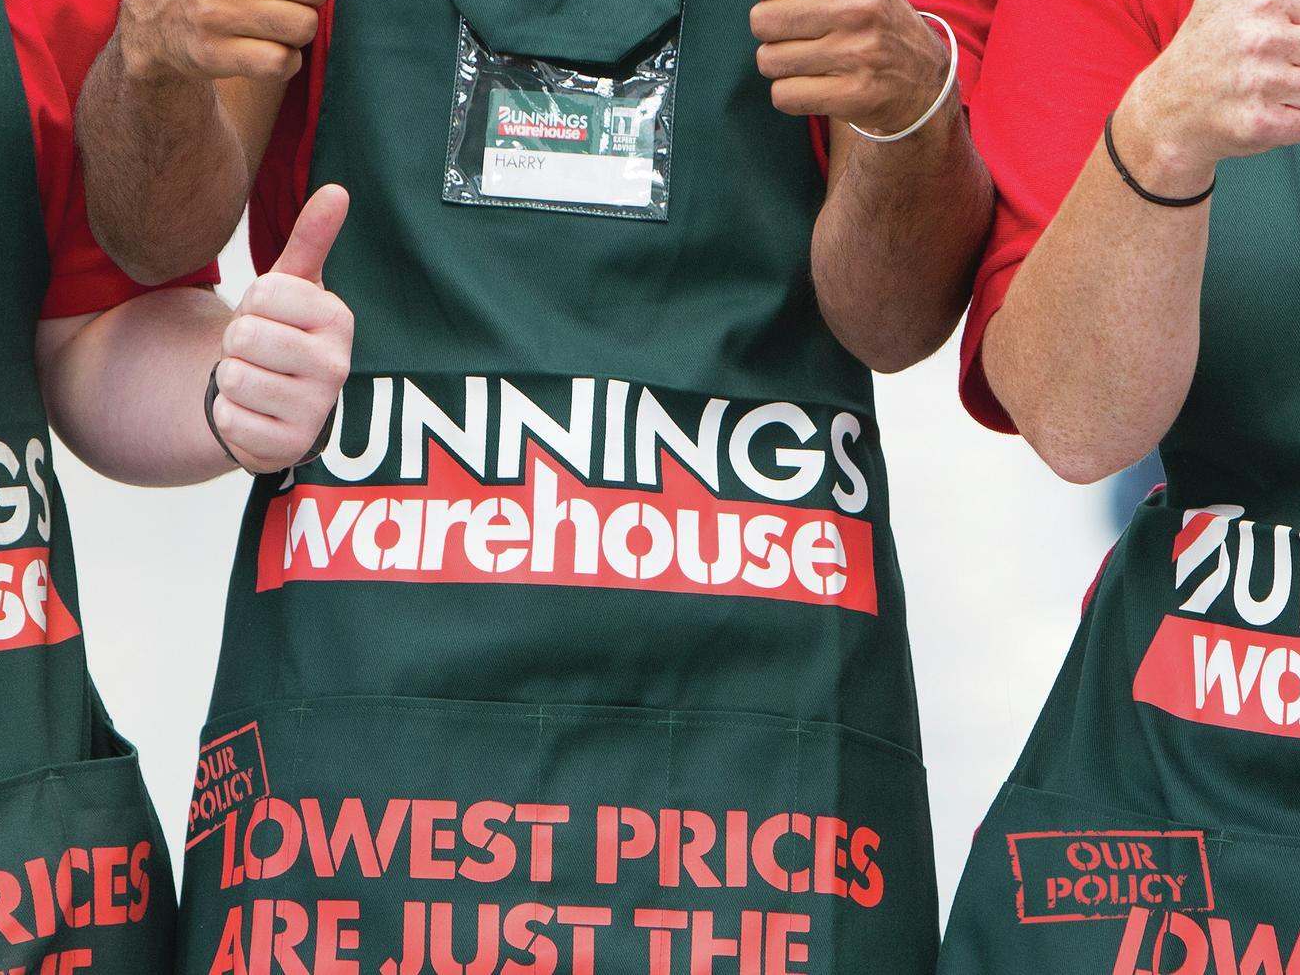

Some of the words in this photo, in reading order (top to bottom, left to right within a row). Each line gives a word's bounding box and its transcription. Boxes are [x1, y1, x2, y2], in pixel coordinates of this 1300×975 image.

[497, 106, 588, 129] BUNNINGS
[503, 122, 581, 140] warehouse
[495, 153, 546, 169] HARRY
[279, 377, 868, 513] UNNINGS
[284, 456, 847, 596] warehouse
[195, 746, 238, 790] OUR
[188, 767, 253, 833] POLICY
[220, 796, 570, 890] LOWEST
[595, 805, 884, 909] PRICES
[1066, 841, 1159, 871] OUR
[1046, 874, 1188, 909] POLICY
[208, 899, 360, 975] ARE
[378, 901, 612, 975] JUST
[633, 908, 812, 975] THE
